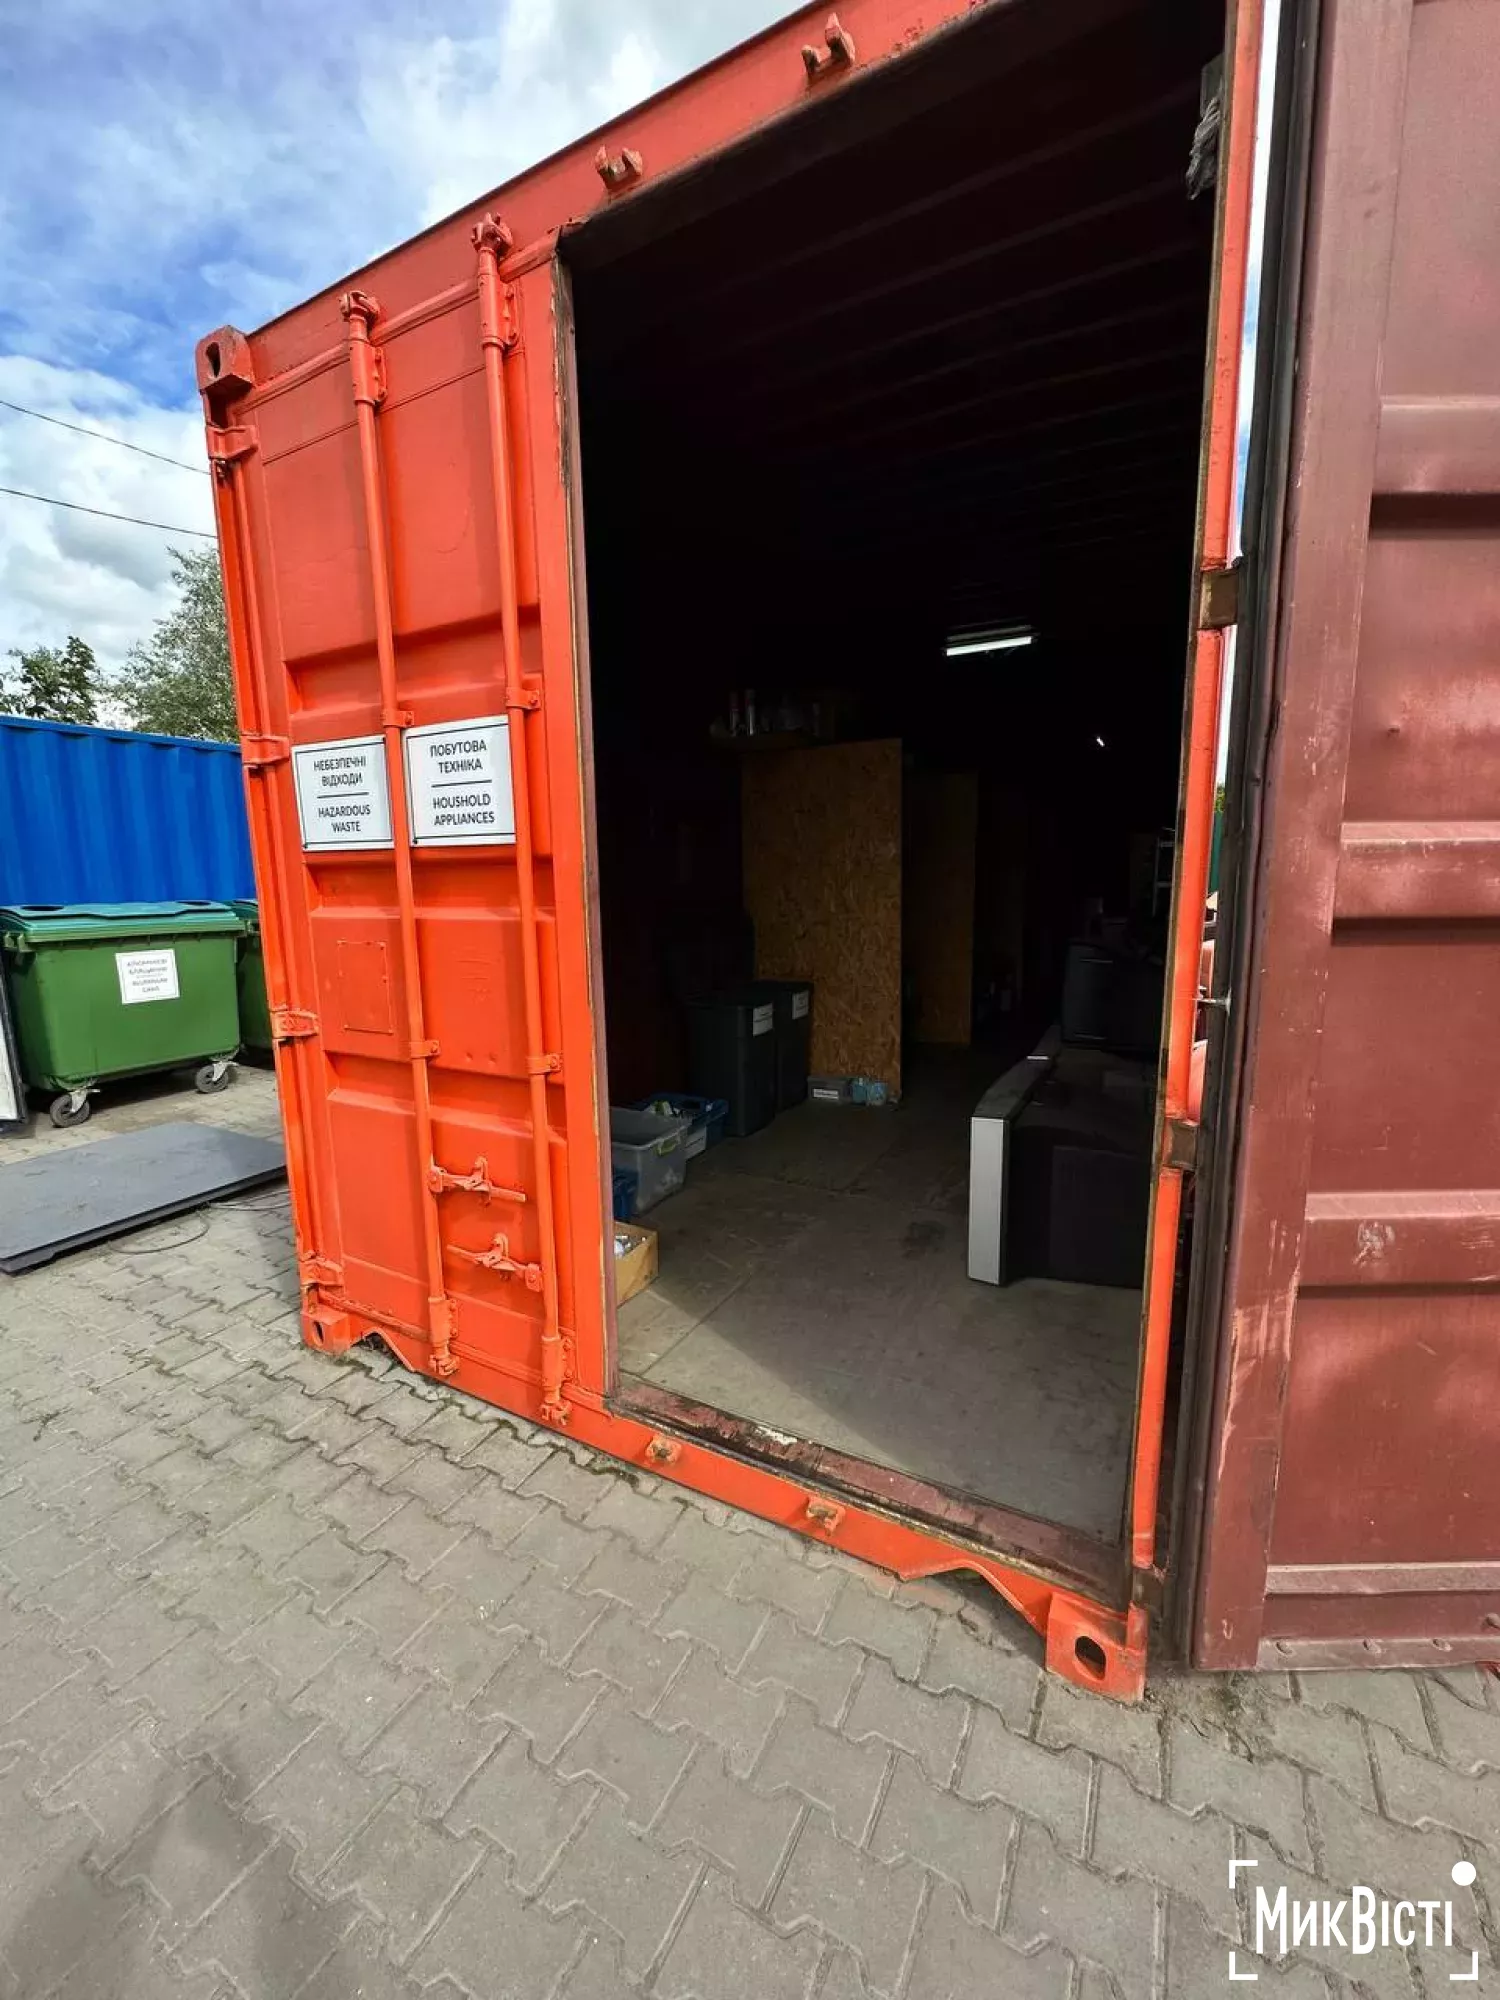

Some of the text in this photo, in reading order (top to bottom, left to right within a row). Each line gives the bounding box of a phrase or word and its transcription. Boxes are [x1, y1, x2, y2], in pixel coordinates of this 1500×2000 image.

[430, 740, 487, 758] ПОБУТОВА
[313, 756, 367, 771] НЕБЕЗПЕЧНІ
[438, 759, 483, 774] ТЕХНІКА
[321, 772, 363, 788] ВІДХОДИ
[433, 793, 491, 809] HOUSHOLD
[318, 804, 371, 818] HAZARDOUS
[434, 811, 495, 826] APPLIANCES
[331, 821, 361, 833] WASTE
